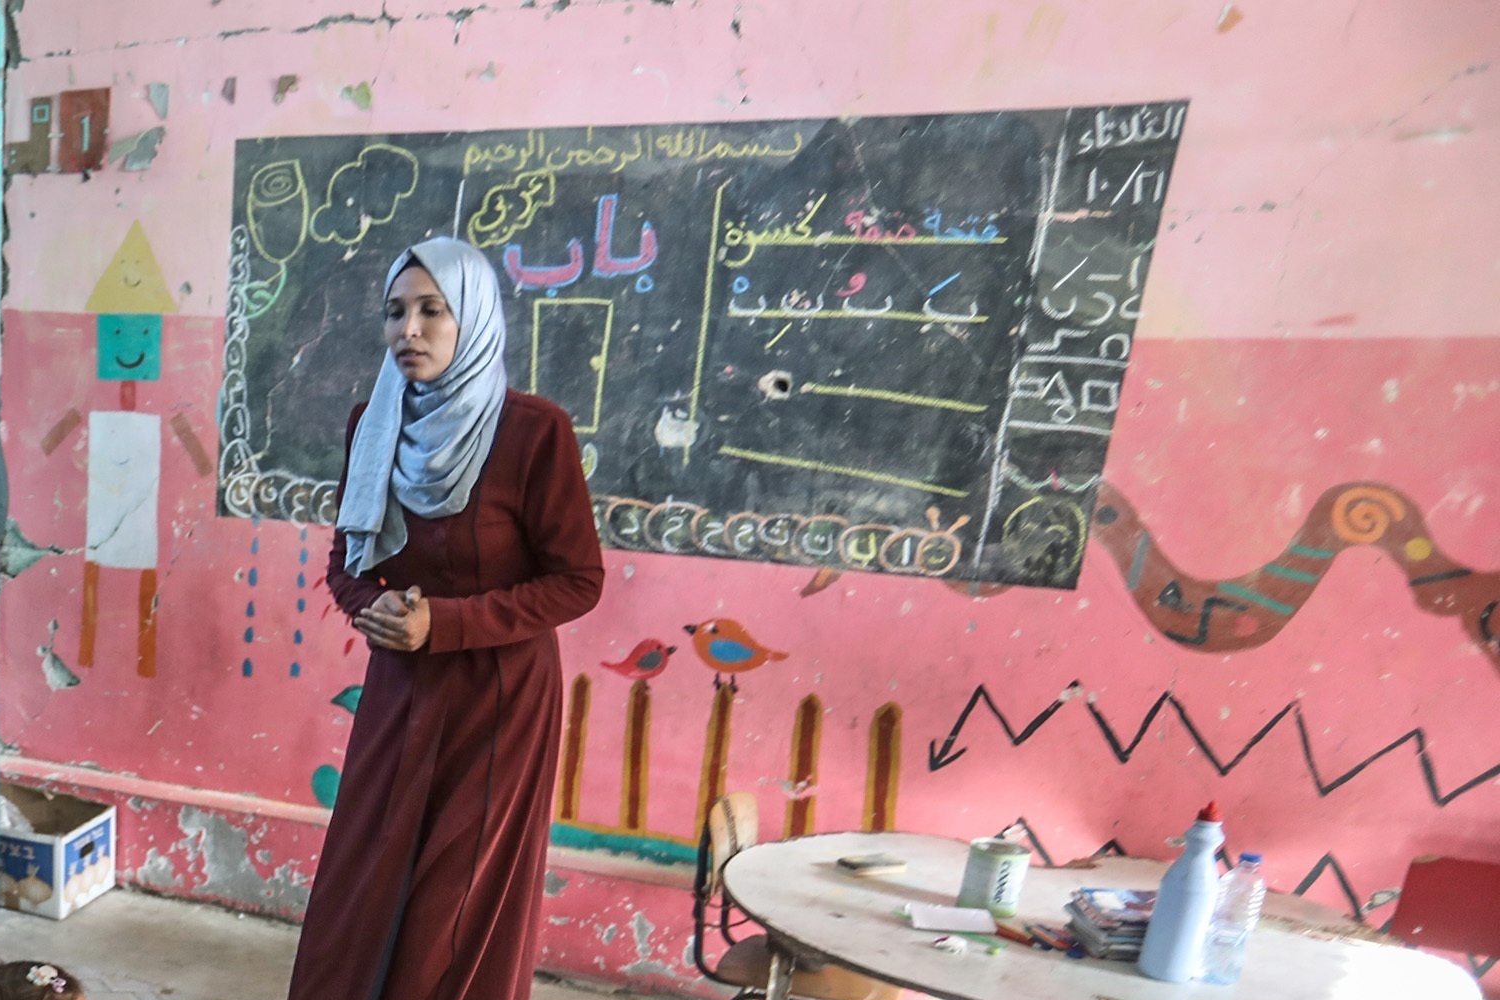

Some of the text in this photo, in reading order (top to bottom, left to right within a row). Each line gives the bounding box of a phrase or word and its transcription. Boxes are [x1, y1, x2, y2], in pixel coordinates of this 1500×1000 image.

[80, 113, 91, 152] 1
[464, 129, 545, 176] الرحيم
[503, 192, 659, 298] باب
